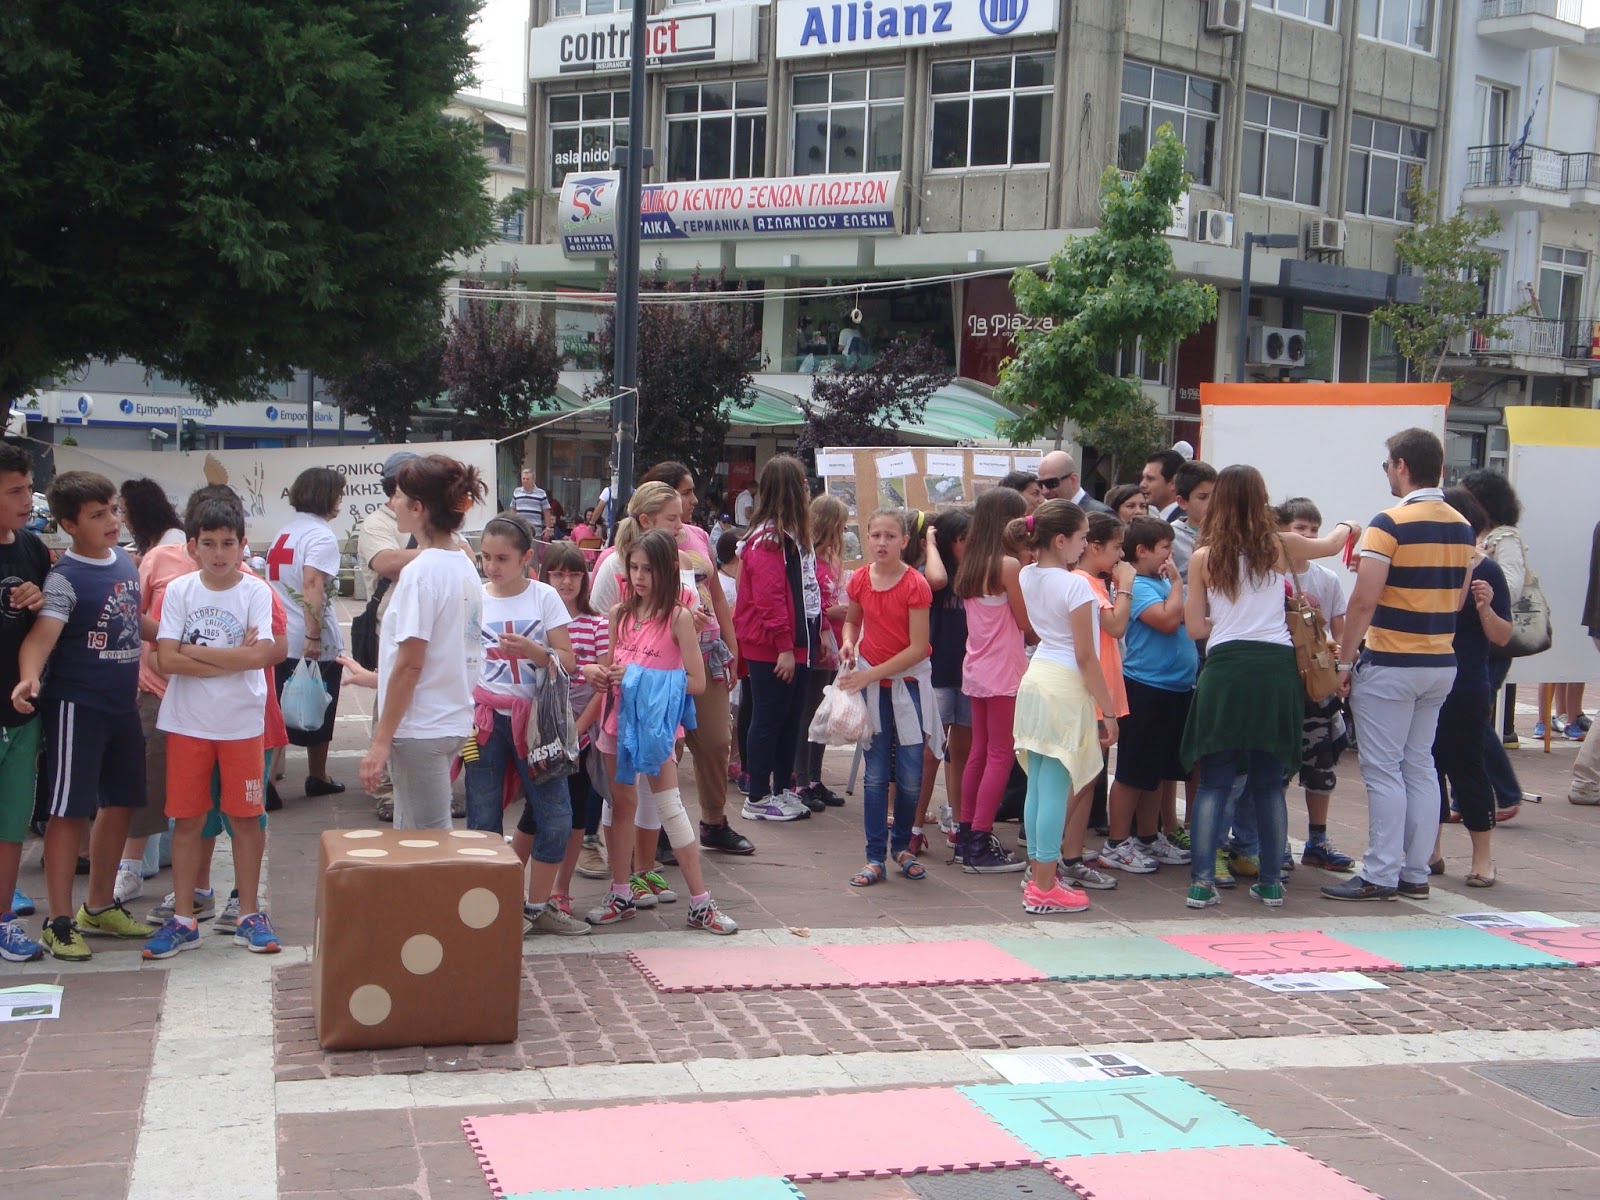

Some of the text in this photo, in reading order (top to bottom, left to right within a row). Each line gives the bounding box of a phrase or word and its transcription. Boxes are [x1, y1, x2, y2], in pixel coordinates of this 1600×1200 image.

[800, 0, 953, 46] Allianz
[560, 18, 680, 62] contrct
[595, 61, 627, 70] INSURANCE
[640, 179, 889, 213] ΔΙΚΟ ΚΕΝΤΡΟ ΞΕΝΩΝ ΓΛΩΣΣΩΝ
[640, 220, 672, 235] ΛΙΚΑ
[682, 218, 750, 233] ΓΕΡΜΑΝΙΚΑ
[567, 235, 611, 244] ΤΜΗΜΑΤΑ
[967, 312, 1056, 337] La Piazza
[136, 403, 177, 418] Εμπορική
[314, 411, 333, 422] Bank
[195, 608, 220, 619] COAST
[203, 628, 220, 637] 1965
[204, 618, 234, 645] CALIFORNIA
[87, 631, 109, 650] 19
